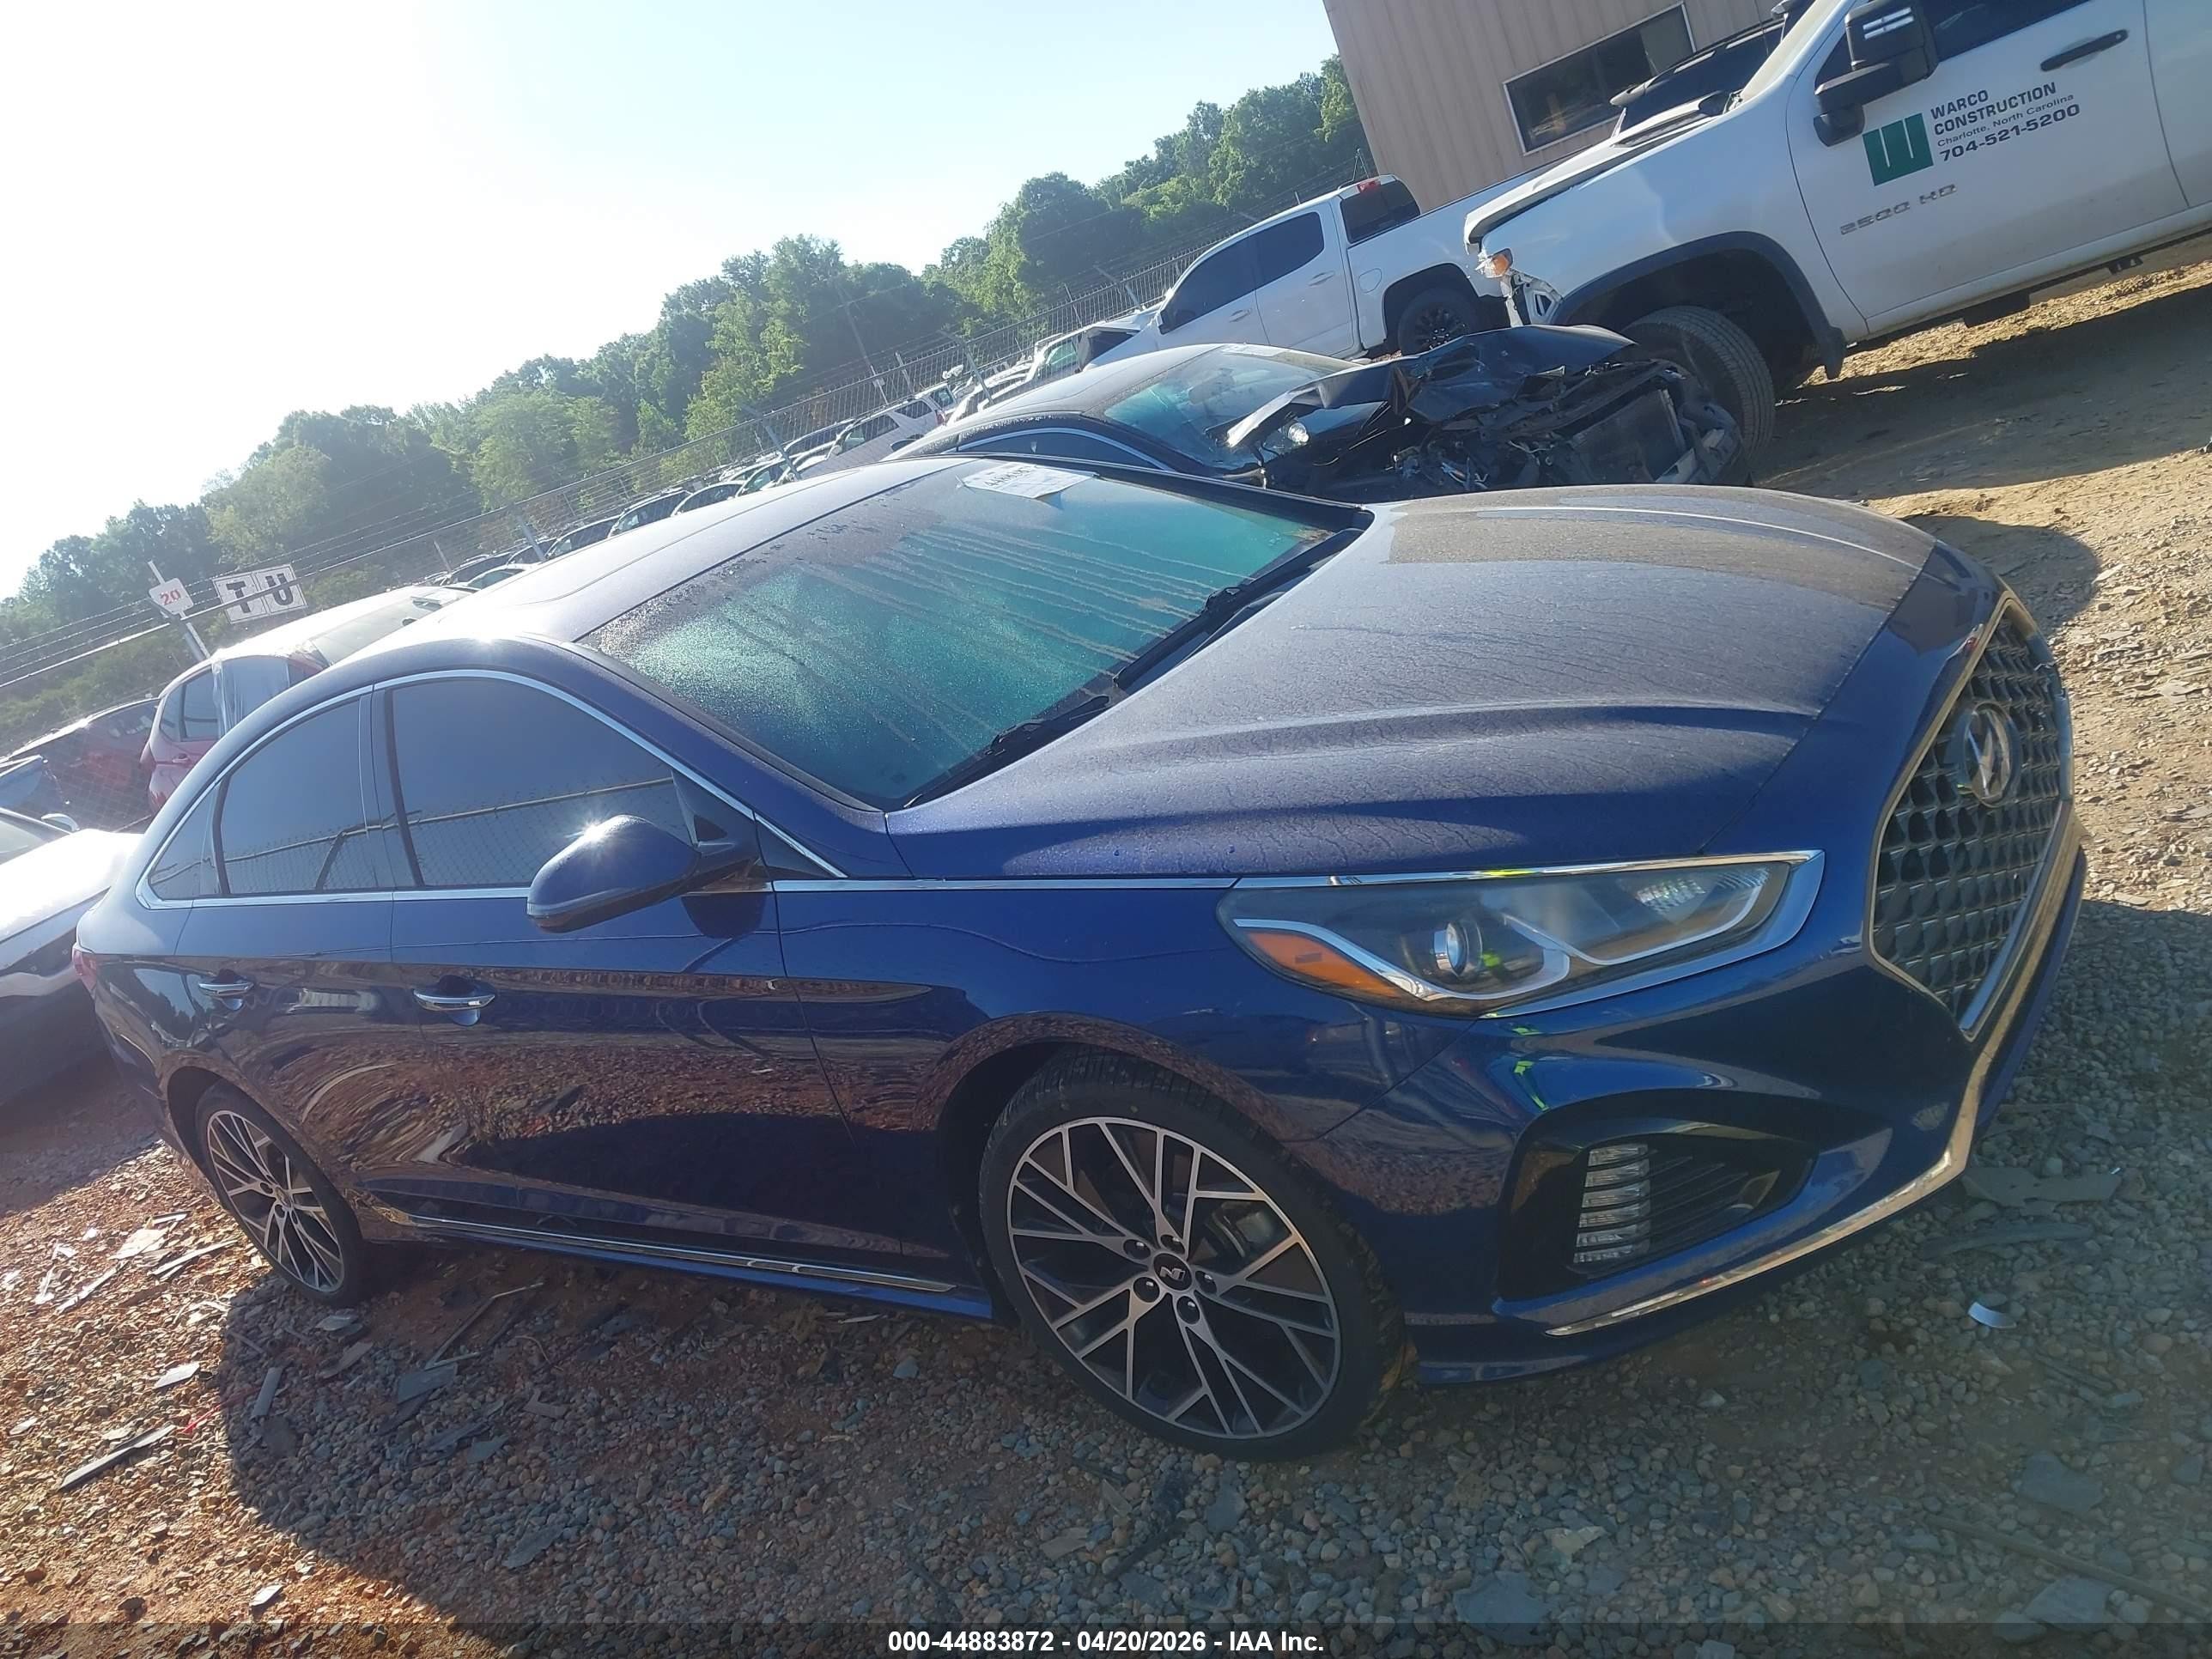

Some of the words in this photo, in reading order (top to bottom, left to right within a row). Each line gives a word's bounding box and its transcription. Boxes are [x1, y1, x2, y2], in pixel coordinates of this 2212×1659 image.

[1930, 89, 1989, 119] WARCO
[1934, 82, 2057, 136] CONSTRUCTION
[1936, 124, 1990, 147] Charlotte,
[1993, 112, 2024, 128] North
[2027, 94, 2075, 115] Carolina
[1939, 104, 2081, 161] 704-521-5200
[1839, 201, 1911, 236] 2500
[1919, 183, 1958, 205] HD
[159, 589, 181, 605] 20
